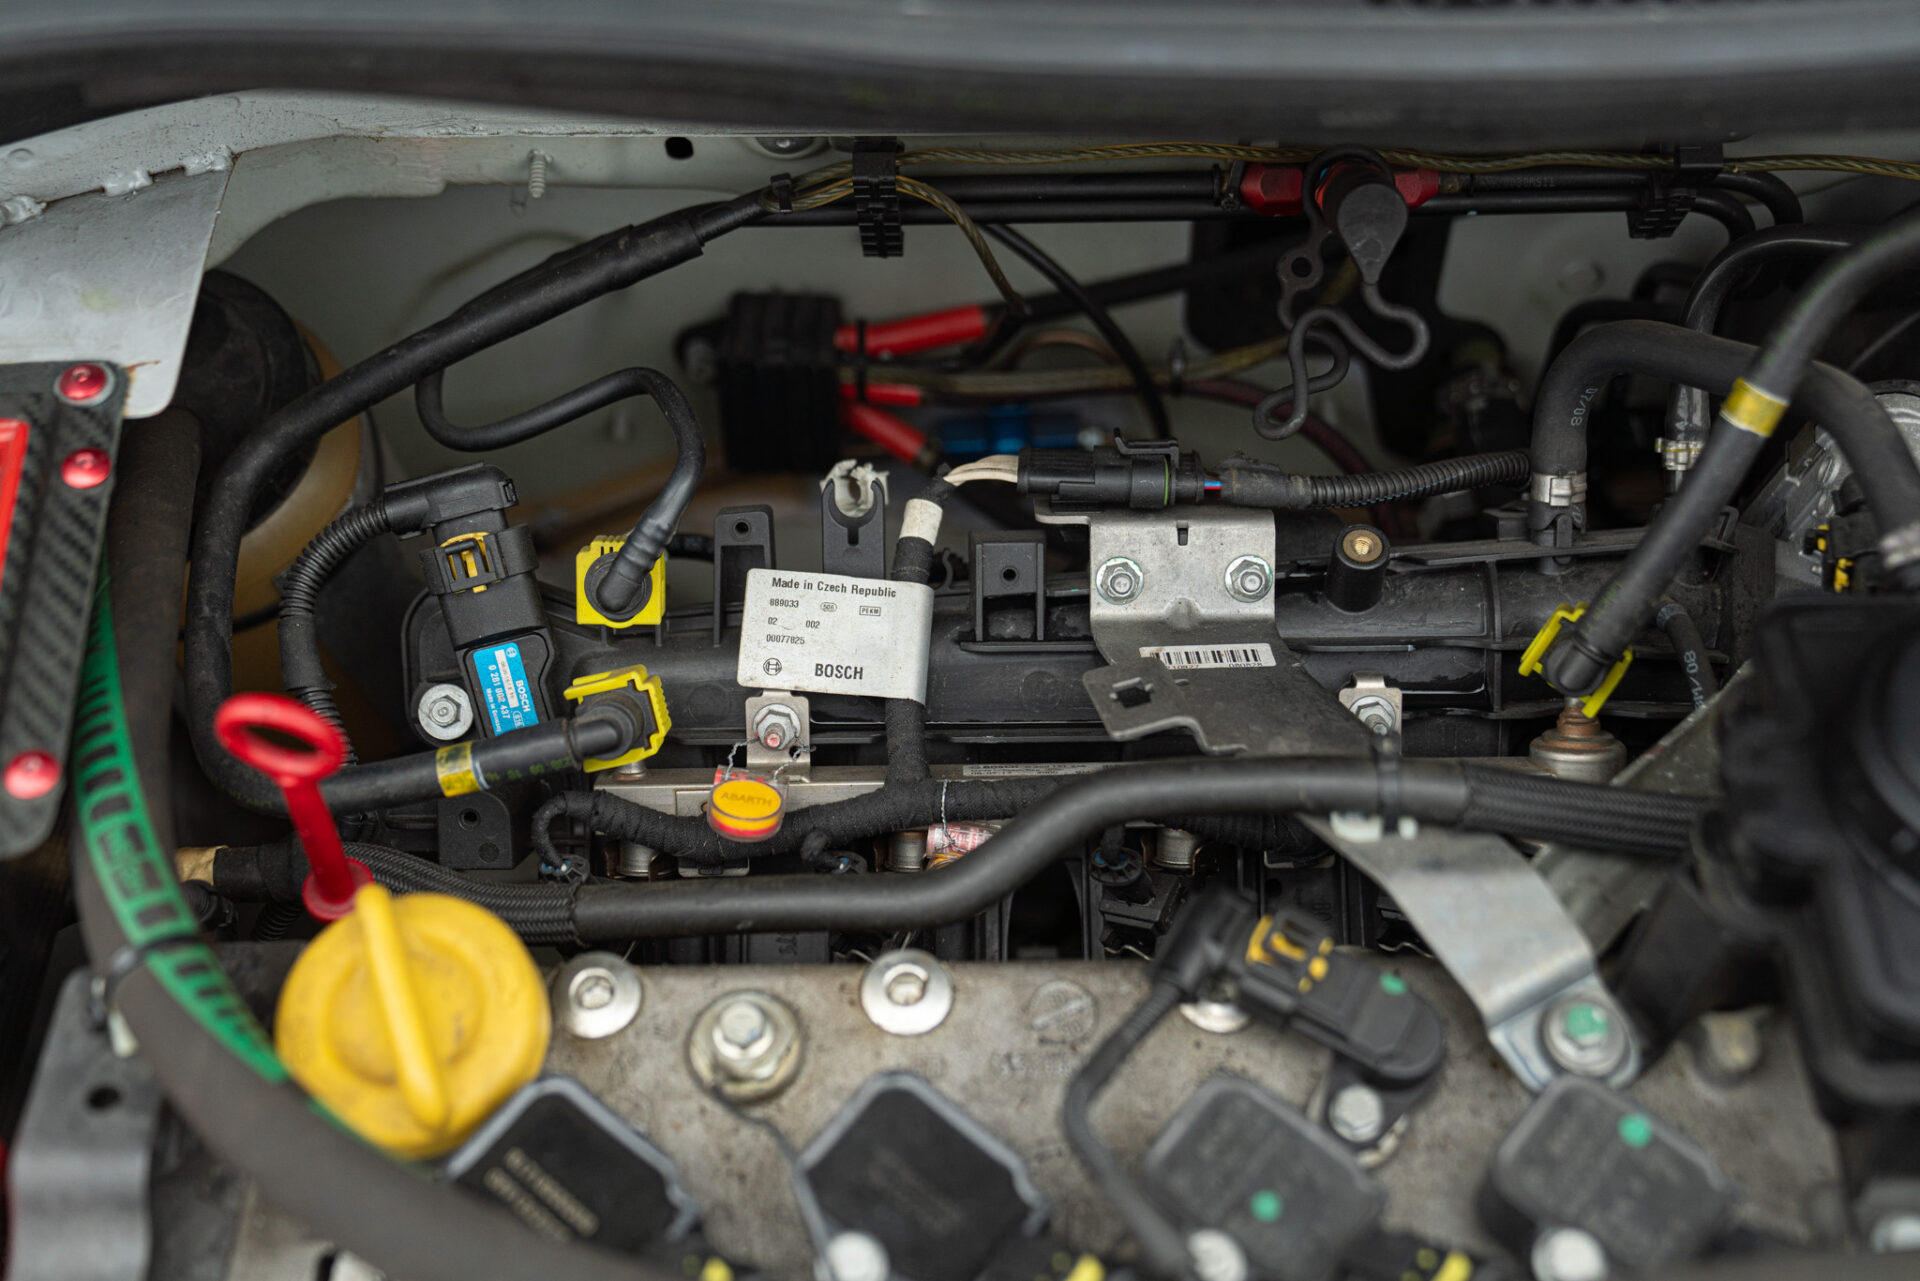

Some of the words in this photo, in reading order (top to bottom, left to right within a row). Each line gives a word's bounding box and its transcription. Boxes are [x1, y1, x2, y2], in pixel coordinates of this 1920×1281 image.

[772, 577, 800, 590] Made
[803, 579, 813, 590] in
[817, 581, 847, 593] Czech
[851, 584, 897, 598] Republic
[769, 598, 799, 608] 889033
[767, 617, 778, 625] 02
[805, 620, 821, 629] 002
[766, 634, 805, 645] 00077825
[814, 663, 864, 680] BOSCH
[490, 672, 501, 686] 281
[495, 688, 506, 703] 002
[515, 680, 531, 712] BOSCH
[501, 705, 511, 719] 437
[721, 792, 773, 807] ABARTH
